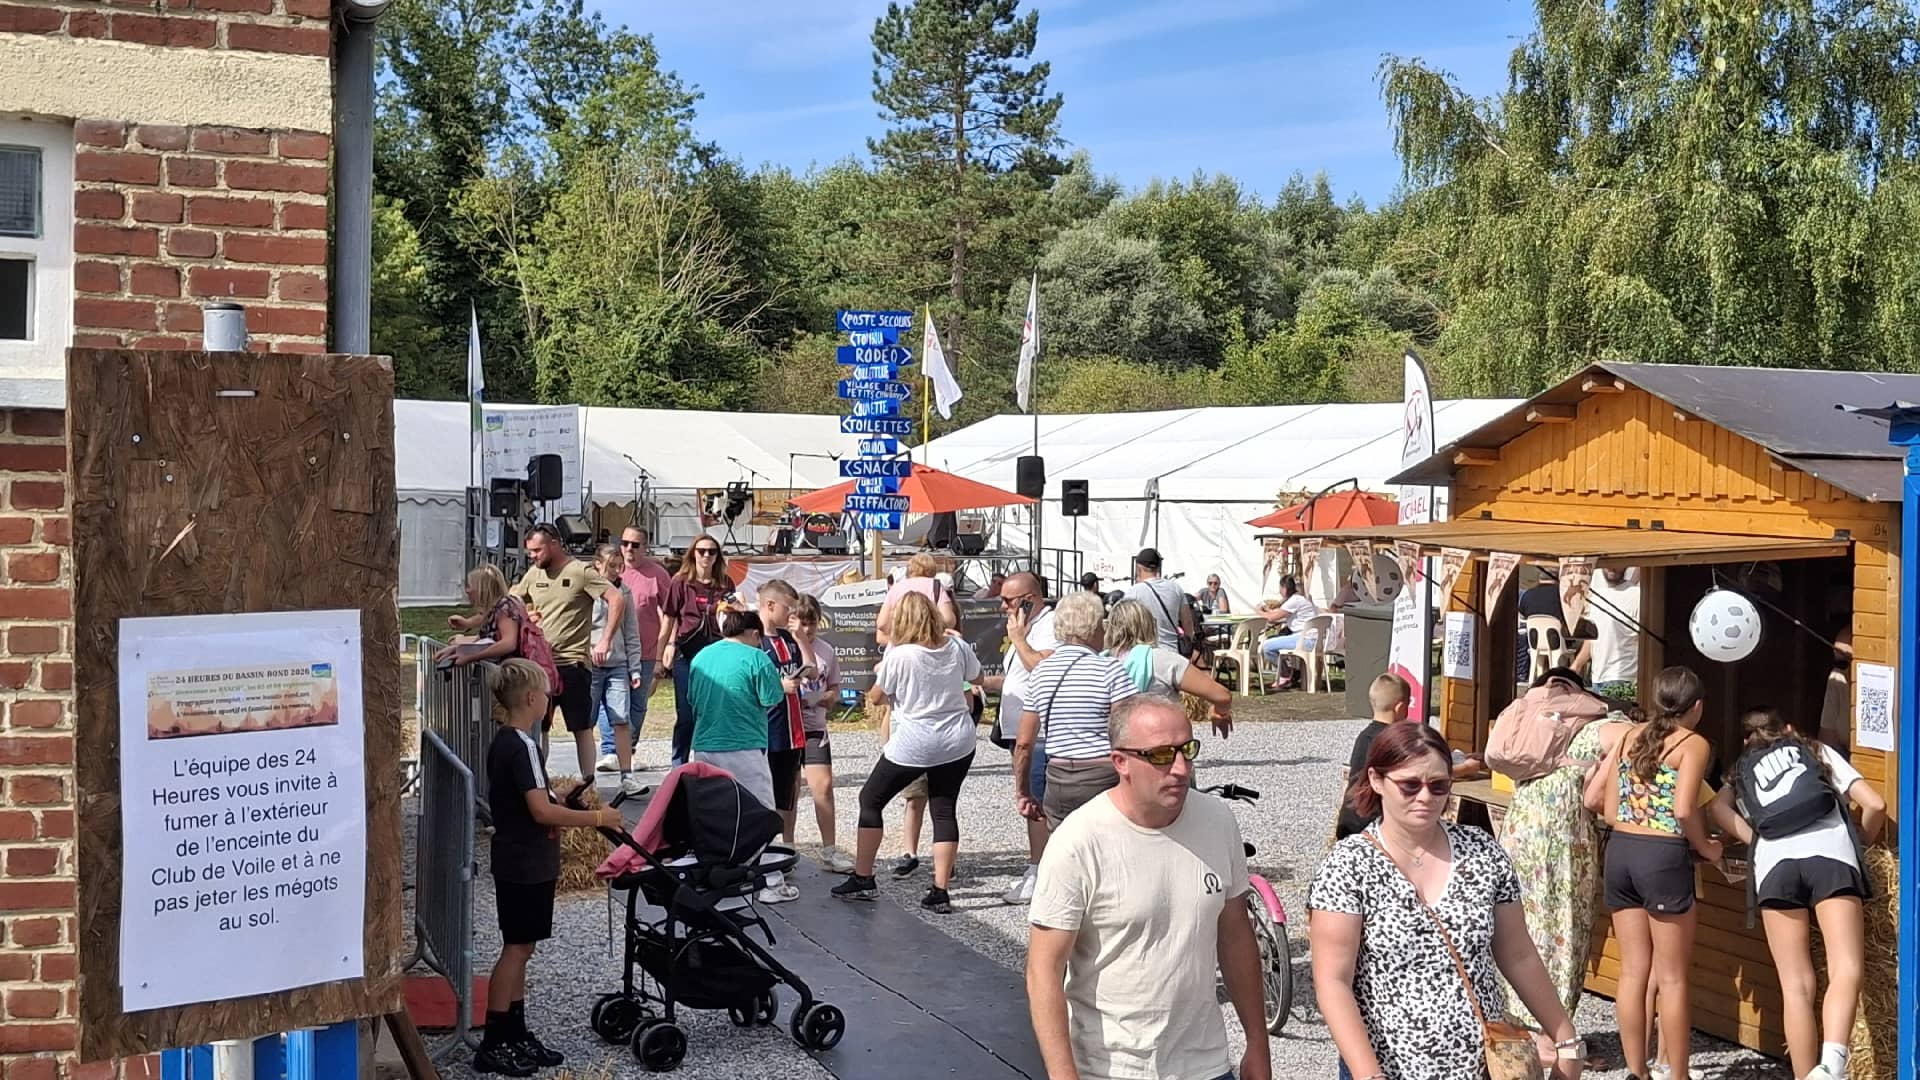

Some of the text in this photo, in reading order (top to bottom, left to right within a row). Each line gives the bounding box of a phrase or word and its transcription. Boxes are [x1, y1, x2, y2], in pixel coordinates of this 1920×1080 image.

[847, 314, 911, 328] POSTE SECOURS
[846, 380, 880, 390] VILLAGE
[847, 388, 874, 398] PETITS
[850, 419, 911, 433] TOILETTES
[853, 462, 901, 475] SNACK
[834, 645, 867, 655] tance
[176, 676, 186, 684] 24
[188, 674, 220, 683] HEURES
[236, 671, 264, 680] BASSIN
[174, 748, 316, 778] L'équipe des 24
[1753, 746, 1801, 789] NIKE
[152, 771, 338, 806] Heures vous invite à
[165, 801, 329, 831] fumer à l'extérieur
[176, 826, 319, 857] de l'enceinte du
[151, 850, 341, 886] Club de Voile et à ne
[154, 875, 338, 916] pas jeter les mégots
[219, 907, 280, 931] au sol.
